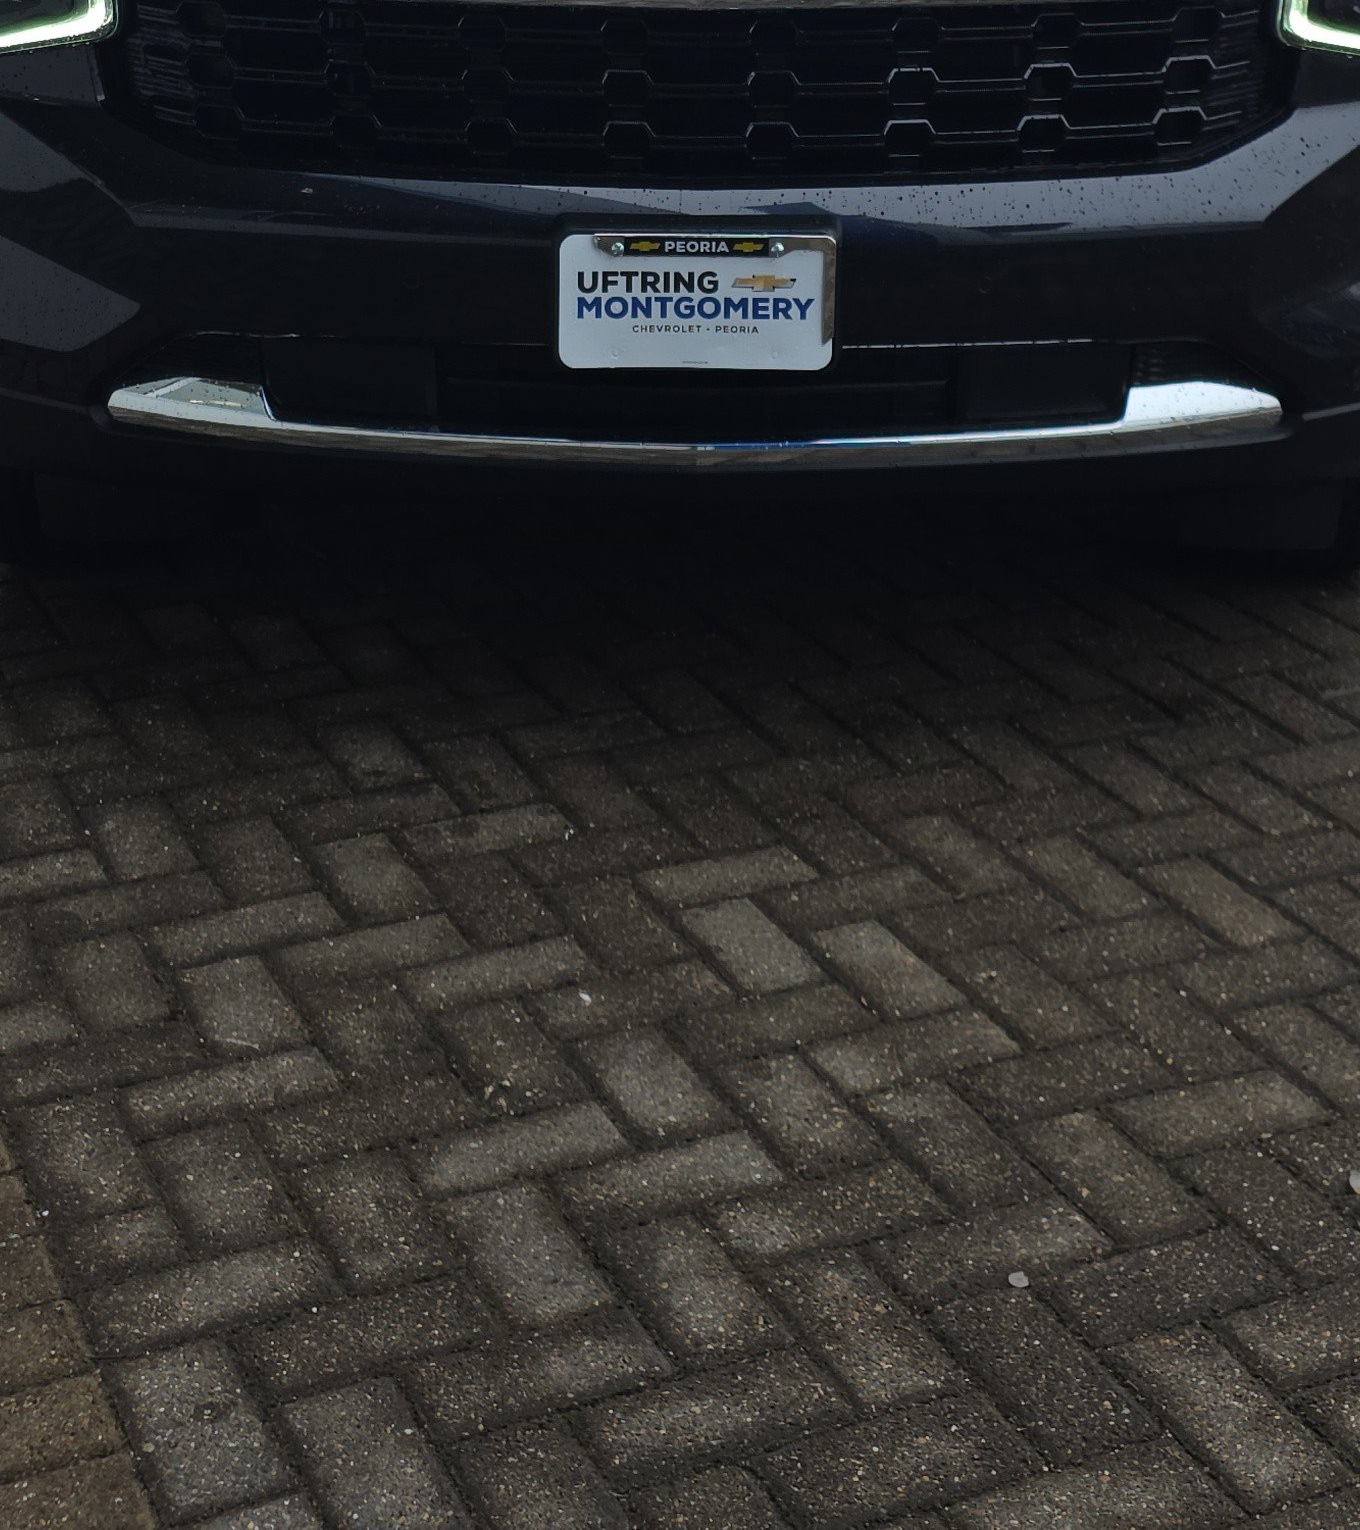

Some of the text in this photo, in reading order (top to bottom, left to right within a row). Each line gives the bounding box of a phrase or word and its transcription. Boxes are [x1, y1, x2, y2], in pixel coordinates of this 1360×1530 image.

[664, 240, 730, 254] PEORIA
[576, 270, 720, 294] UFTRING
[576, 296, 816, 320] MONTGOMERY
[632, 324, 760, 335] CHEVROLET PEORIA
